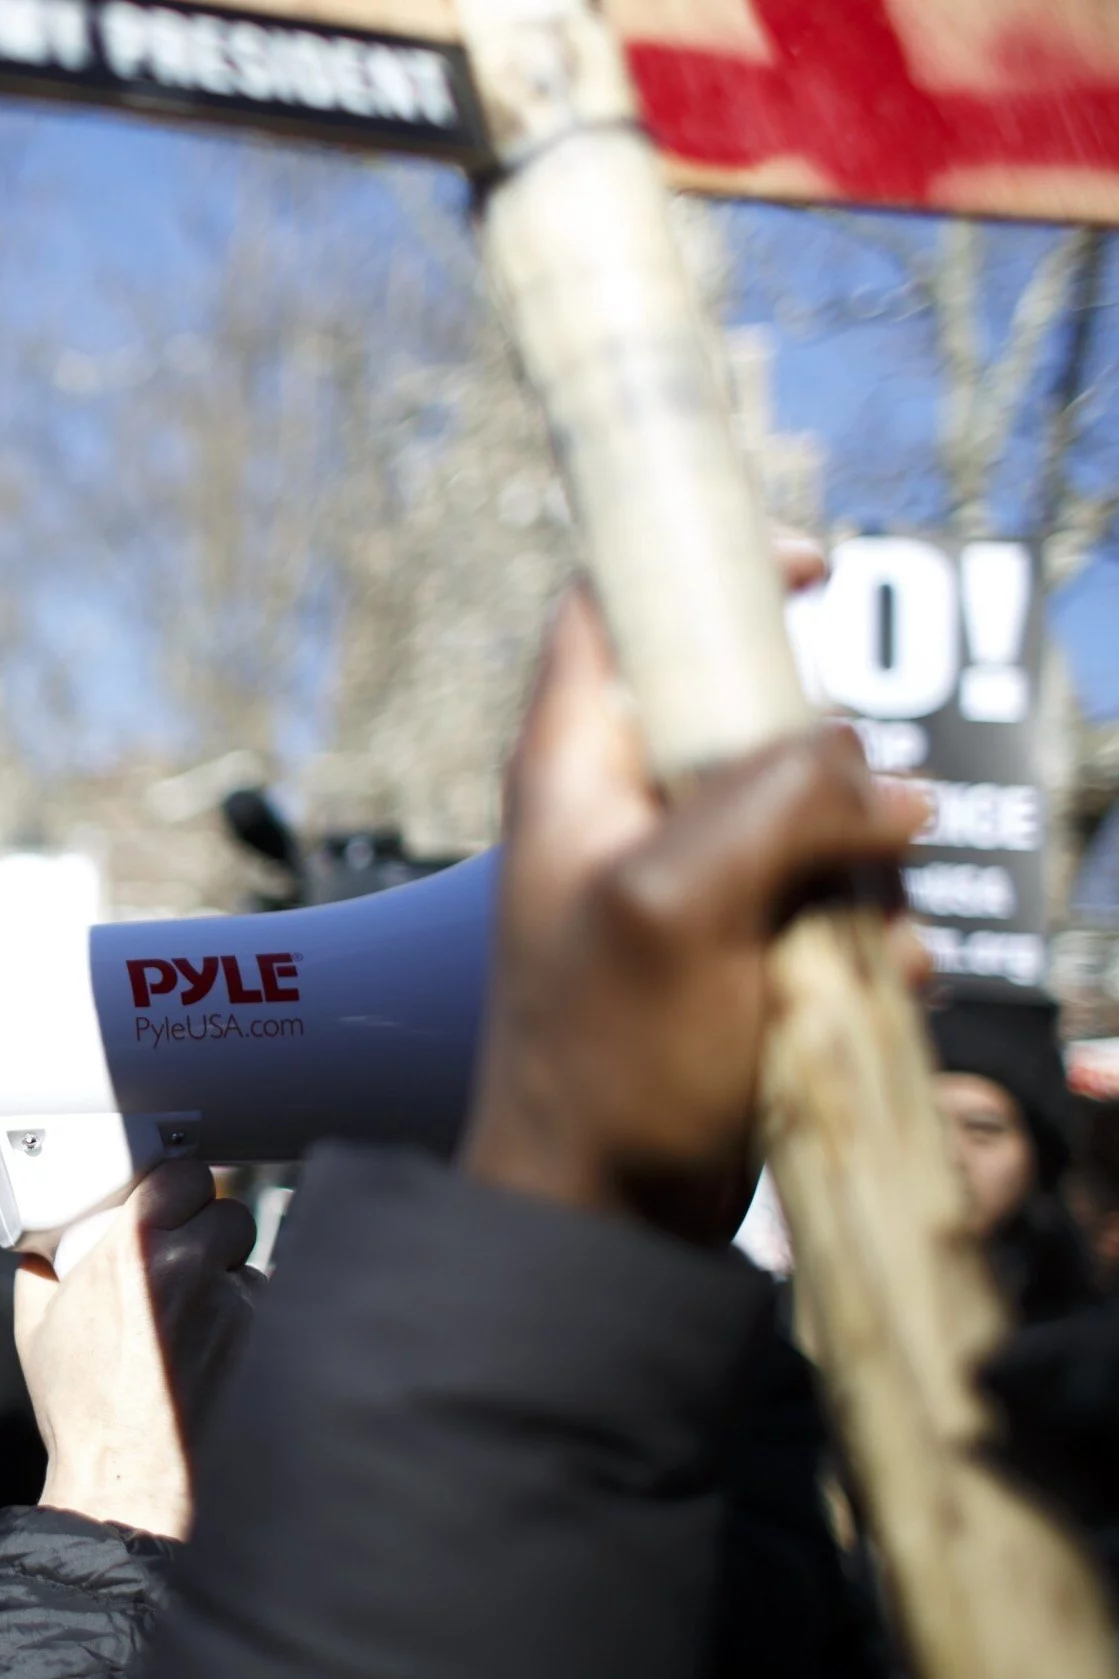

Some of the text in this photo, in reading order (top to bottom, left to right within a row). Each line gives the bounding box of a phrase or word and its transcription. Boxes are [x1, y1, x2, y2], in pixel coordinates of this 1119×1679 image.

[101, 3, 459, 126] PRESIDENT
[787, 537, 1031, 722] O!
[126, 952, 300, 1008] PYLE
[135, 1014, 304, 1049] PyleUSA.com
